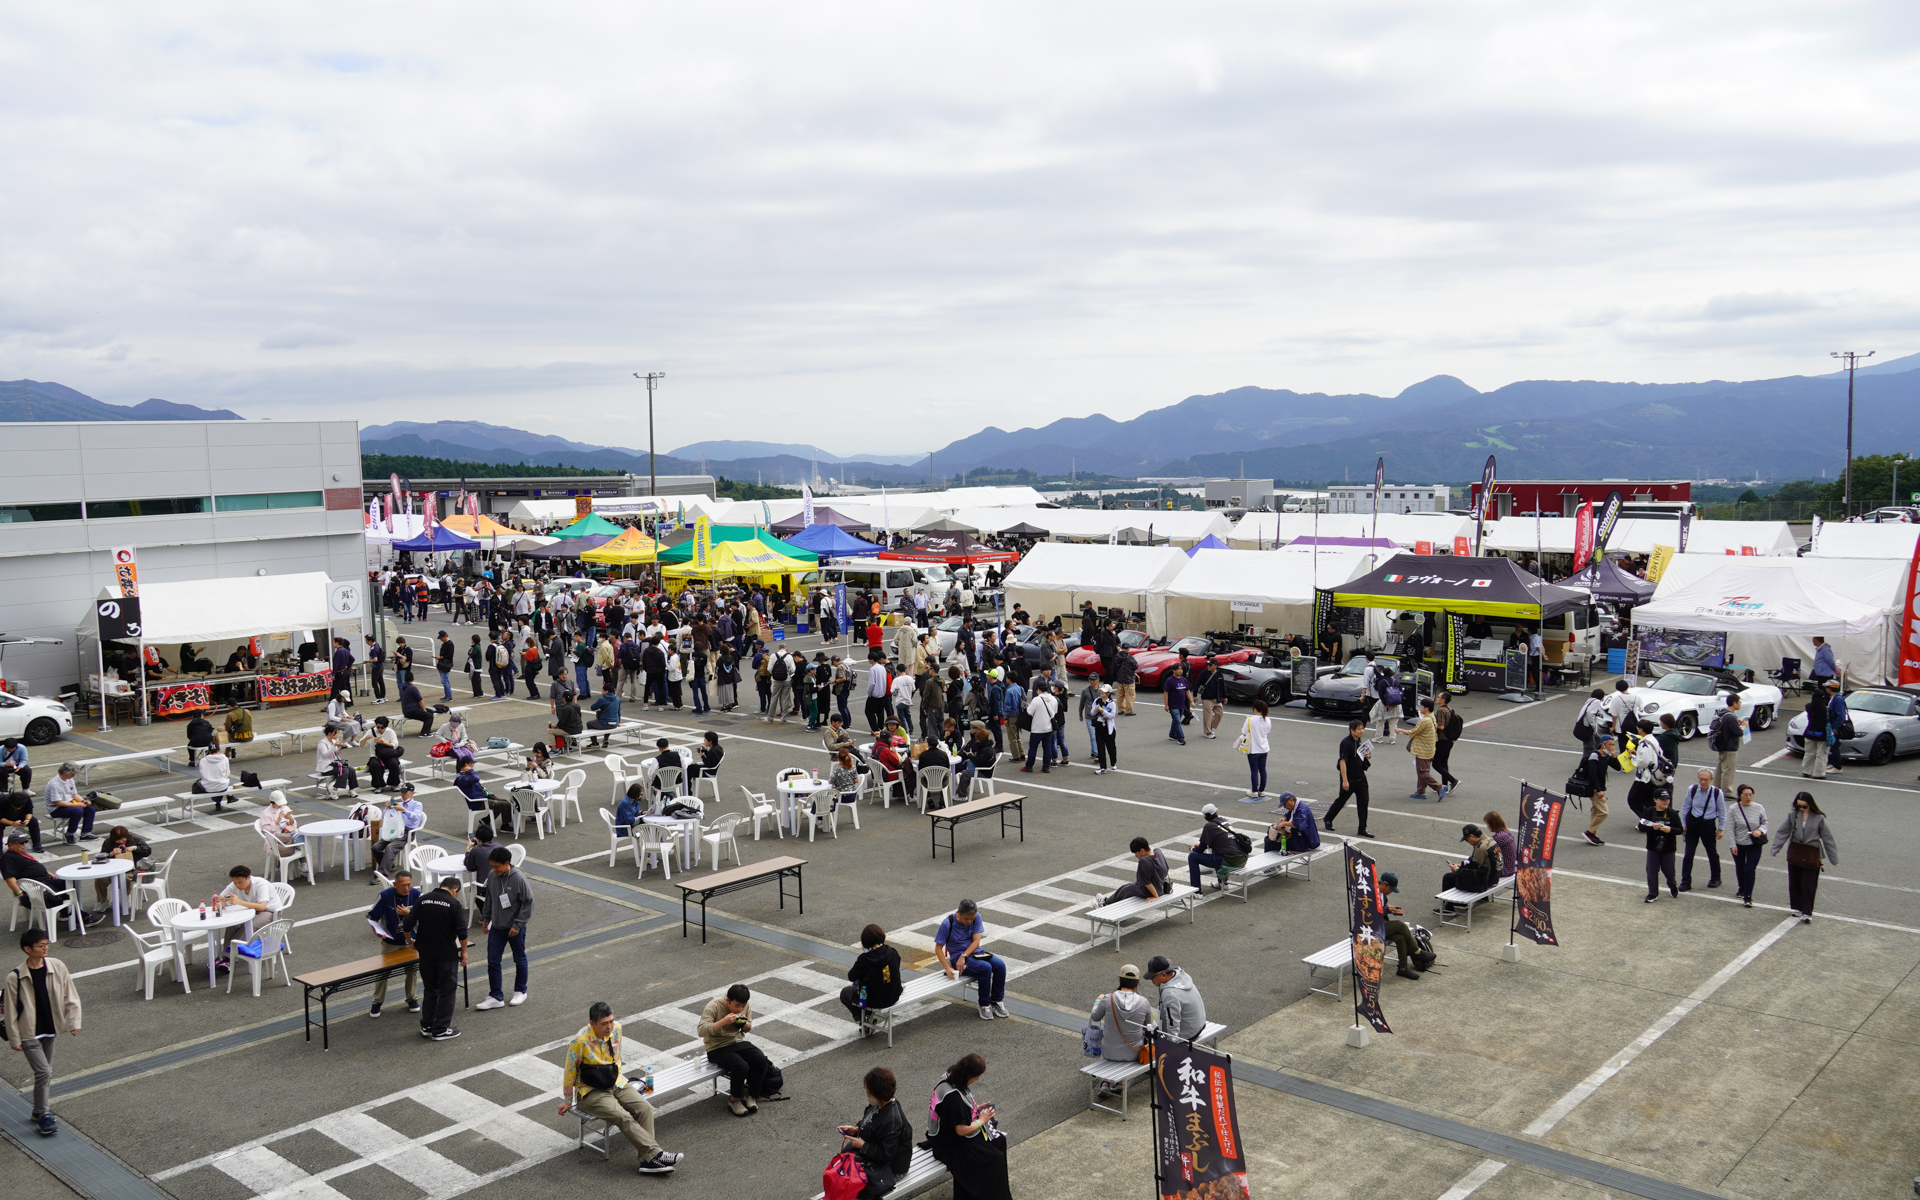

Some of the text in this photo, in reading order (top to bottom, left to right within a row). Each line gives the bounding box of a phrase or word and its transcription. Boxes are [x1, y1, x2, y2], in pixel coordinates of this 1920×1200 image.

[1406, 574, 1469, 586] ラヴォーノ
[1695, 607, 1778, 617] 日本自動車大学校
[268, 674, 327, 696] お好み焼
[1528, 797, 1550, 861] 和牛まぶし
[434, 900, 451, 908] MAZDA
[1354, 858, 1376, 945] 和牛すじ丼
[1177, 1057, 1210, 1173] 和牛まぶし
[1214, 1070, 1233, 1155] 秘伝の特製だれで仕上げた
